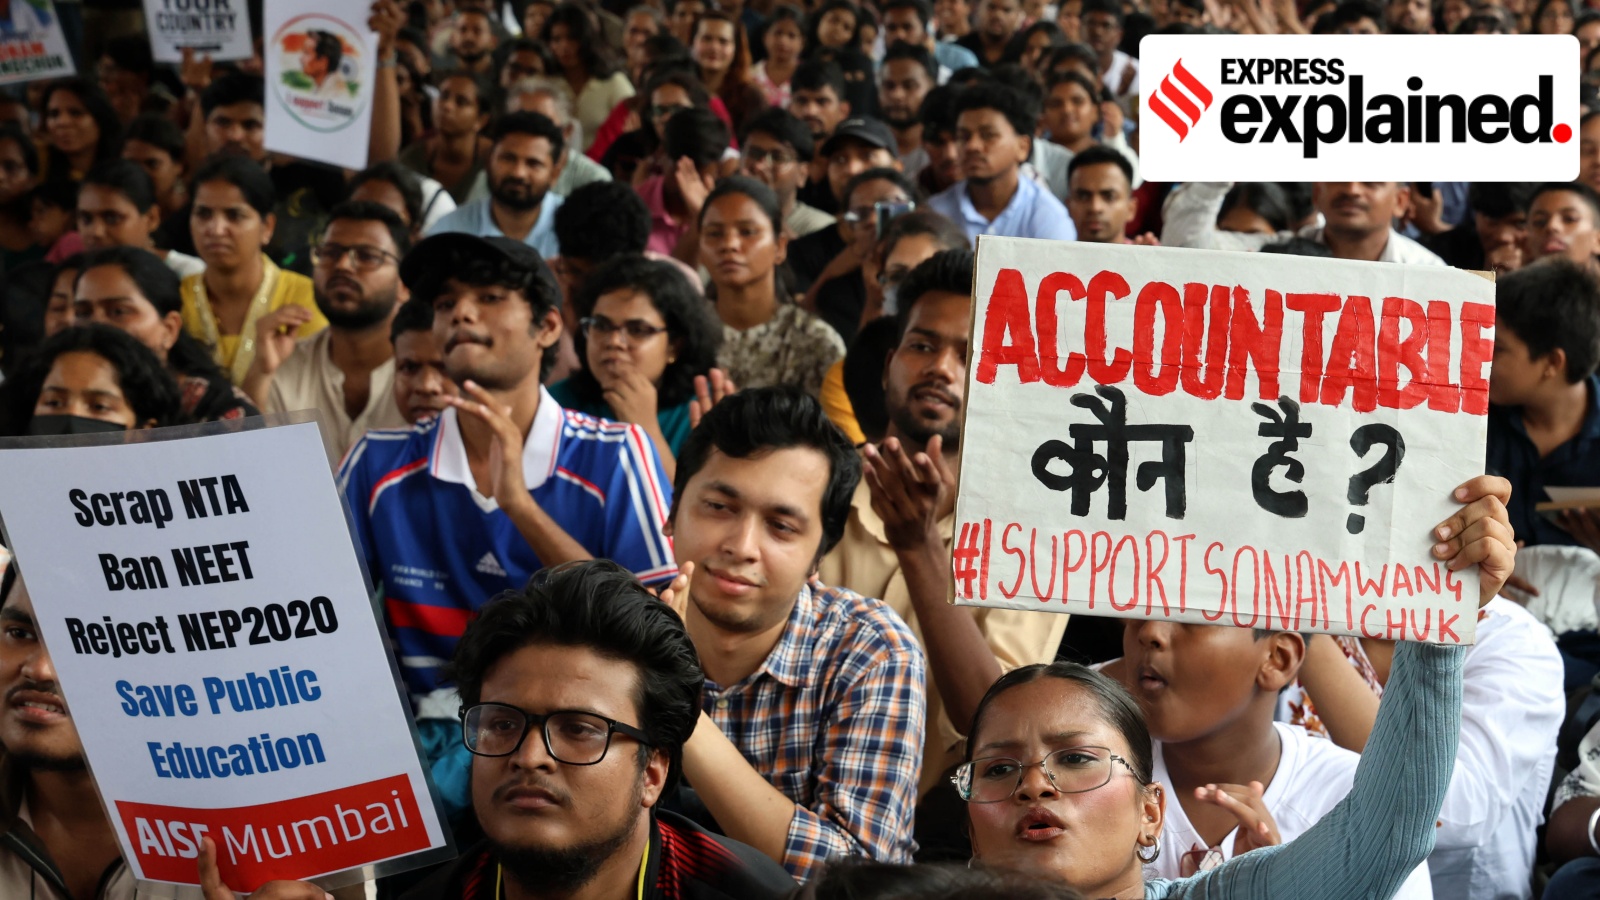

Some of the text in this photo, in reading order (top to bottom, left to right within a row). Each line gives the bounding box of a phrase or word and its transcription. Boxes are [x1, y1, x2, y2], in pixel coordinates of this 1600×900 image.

[156, 12, 236, 33] COUNTRY
[976, 268, 1495, 416] ACCOUNTABLE
[1031, 384, 1194, 520] कौन
[1251, 395, 1312, 518] है
[69, 475, 249, 528] Scrap NTA
[98, 541, 254, 591] Ban NEET
[65, 596, 338, 658] Reject NEP2020
[1360, 604, 1461, 643] CHUK
[115, 665, 322, 717] Save Public
[146, 732, 326, 780] Education
[222, 789, 409, 865] Mumbai
